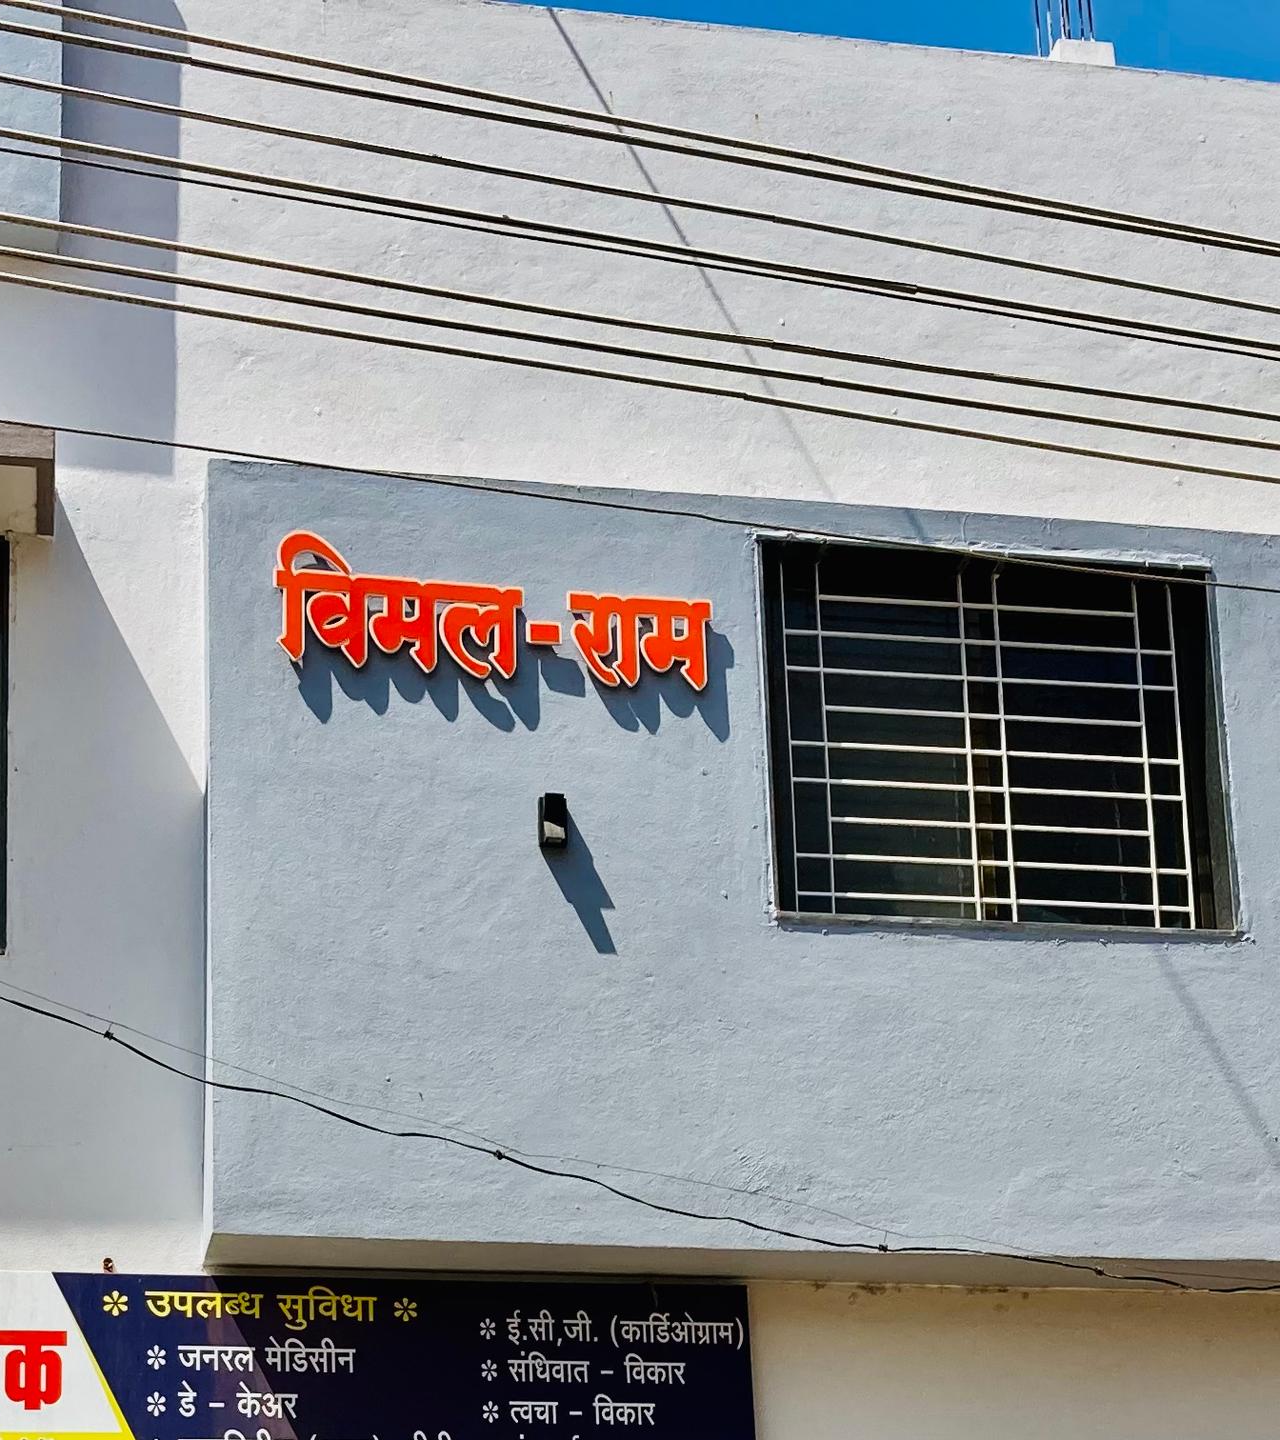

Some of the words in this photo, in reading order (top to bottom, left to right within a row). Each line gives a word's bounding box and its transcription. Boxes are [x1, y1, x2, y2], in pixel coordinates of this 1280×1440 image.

[273, 529, 713, 691] विमल-राम
[145, 1289, 262, 1320] उपलब्ध
[277, 1285, 377, 1330] सुविधा
[611, 1311, 745, 1350] (कार्डिओग्राम)
[178, 1344, 255, 1373] जनरल
[265, 1336, 356, 1374] मेडिसीन
[508, 1350, 590, 1384] संधिवात
[623, 1353, 686, 1385] विकार
[177, 1381, 198, 1418] डे
[237, 1382, 298, 1420] केअर
[510, 1400, 559, 1426] त्वचा
[593, 1394, 656, 1427] विकार
